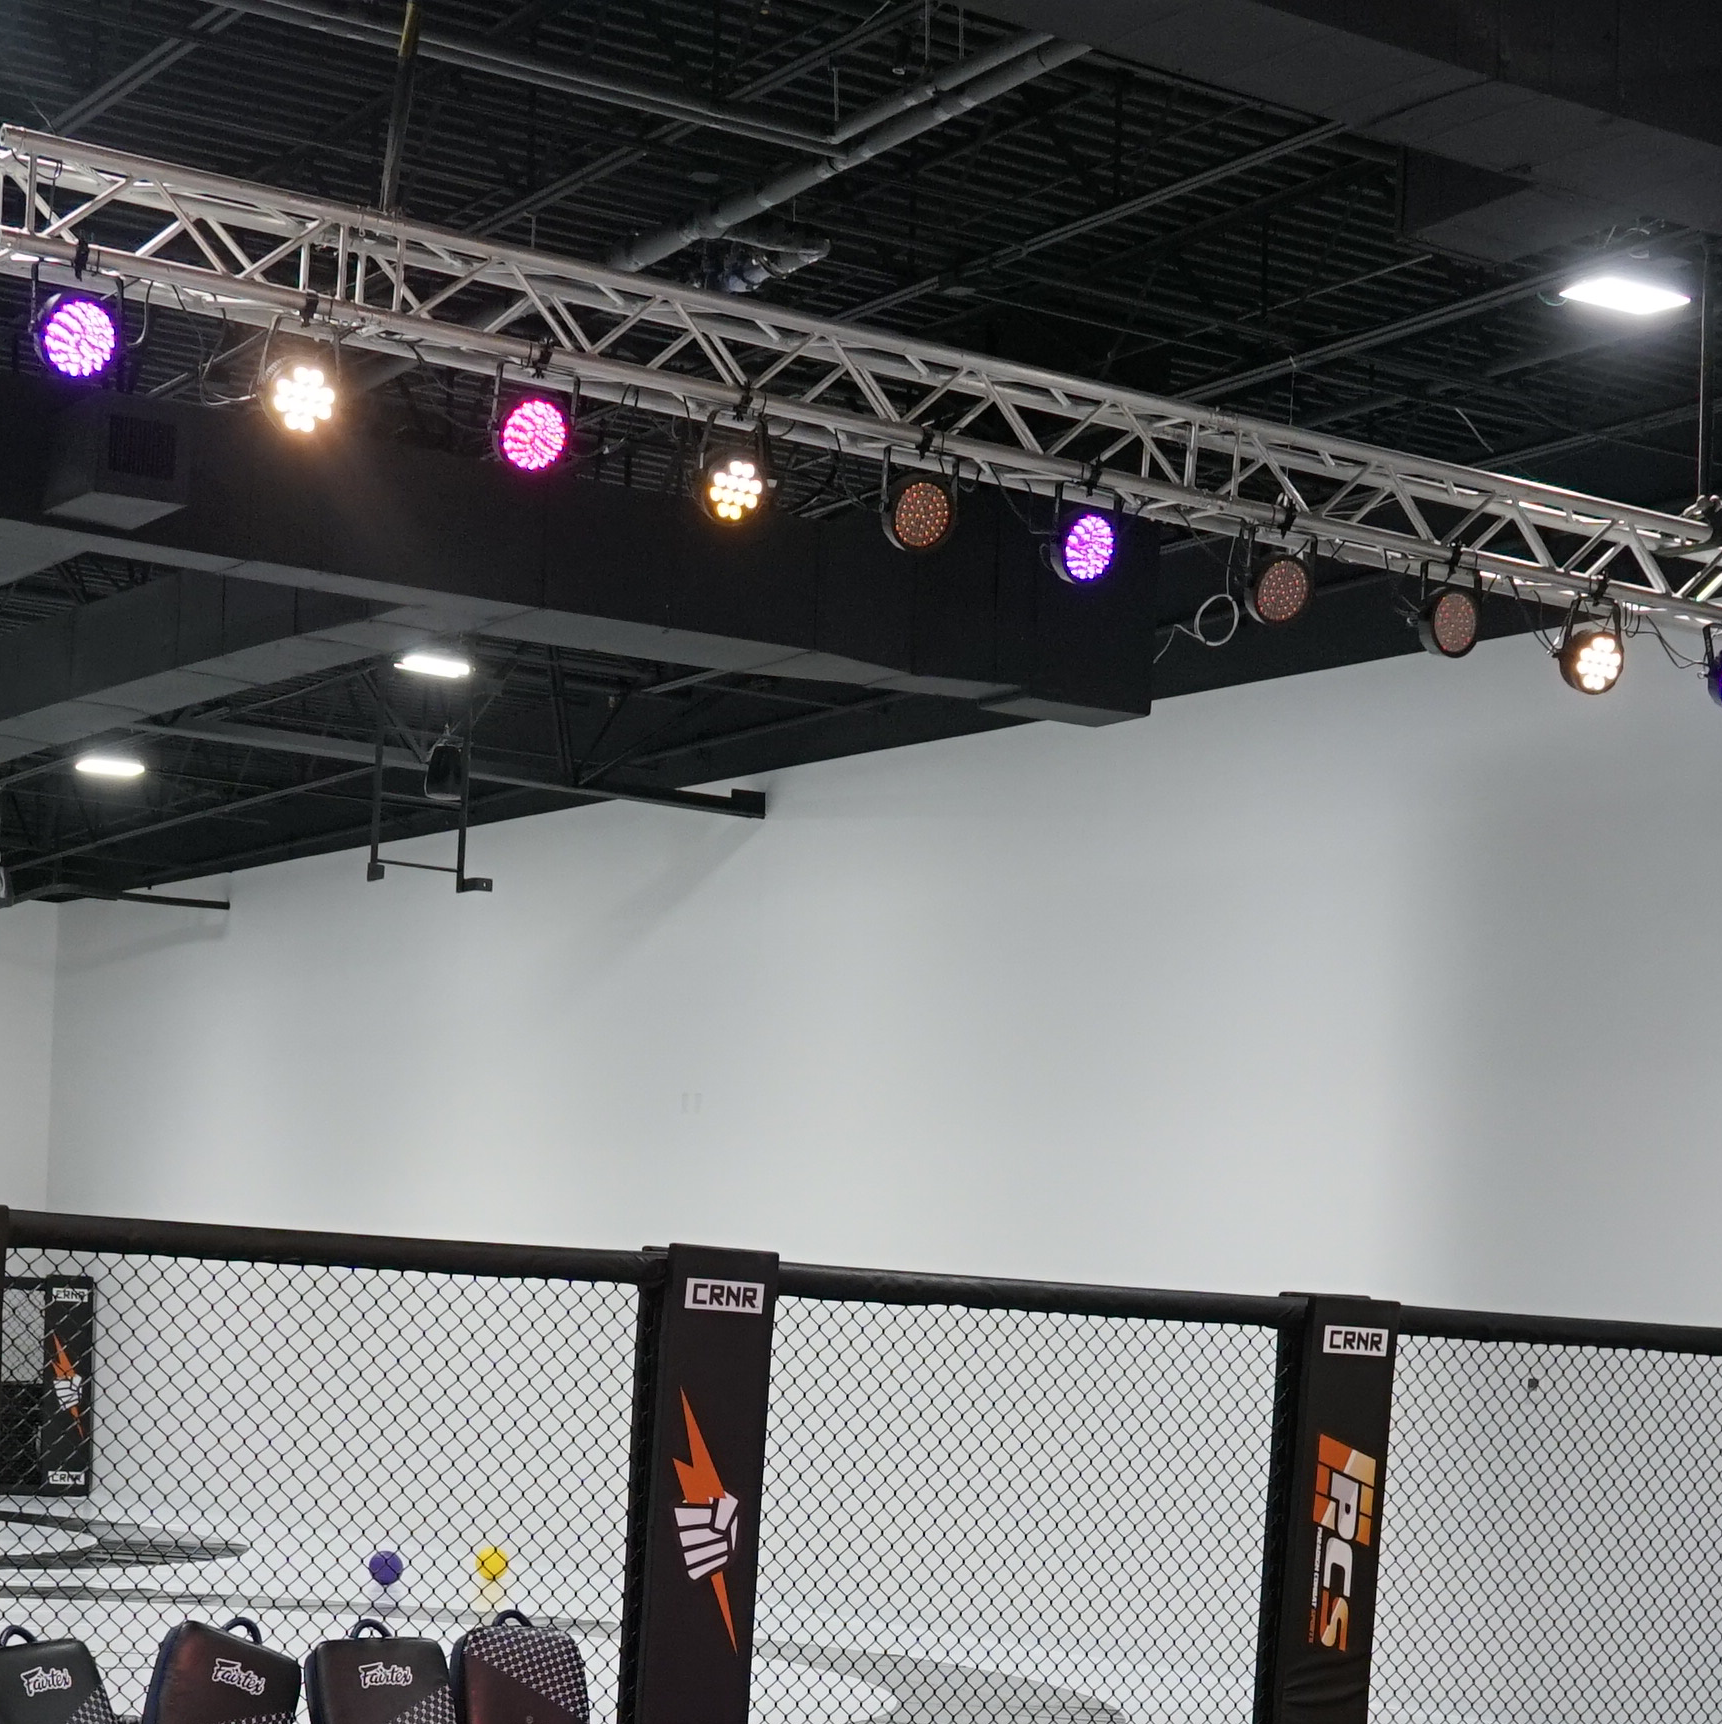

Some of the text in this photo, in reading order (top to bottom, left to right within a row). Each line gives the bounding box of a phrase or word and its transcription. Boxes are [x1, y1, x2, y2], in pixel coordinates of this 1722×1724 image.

[692, 1283, 757, 1308] CRNR
[1329, 1330, 1382, 1352] CRNR
[1319, 1471, 1360, 1652] PCS
[20, 1666, 73, 1697] Fairtex
[212, 1657, 266, 1696] Fairtex
[358, 1661, 413, 1689] Fairtex
